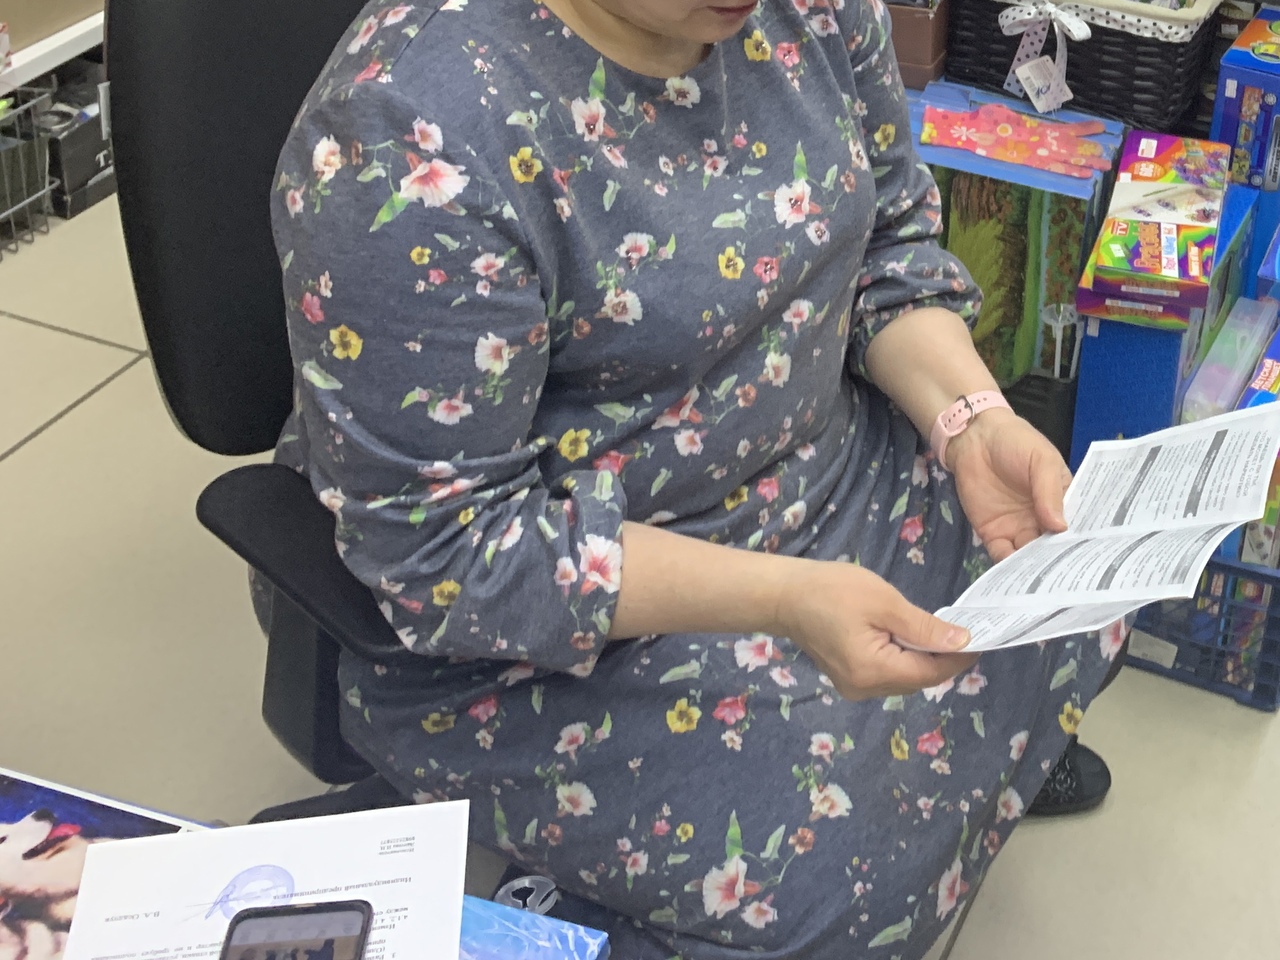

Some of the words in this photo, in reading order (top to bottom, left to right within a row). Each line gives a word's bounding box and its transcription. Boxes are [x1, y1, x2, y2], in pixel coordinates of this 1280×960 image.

[1117, 220, 1128, 235] TV
[1251, 359, 1273, 389] ДЕТСКИЙ
[344, 877, 412, 891] Индивидуальный
